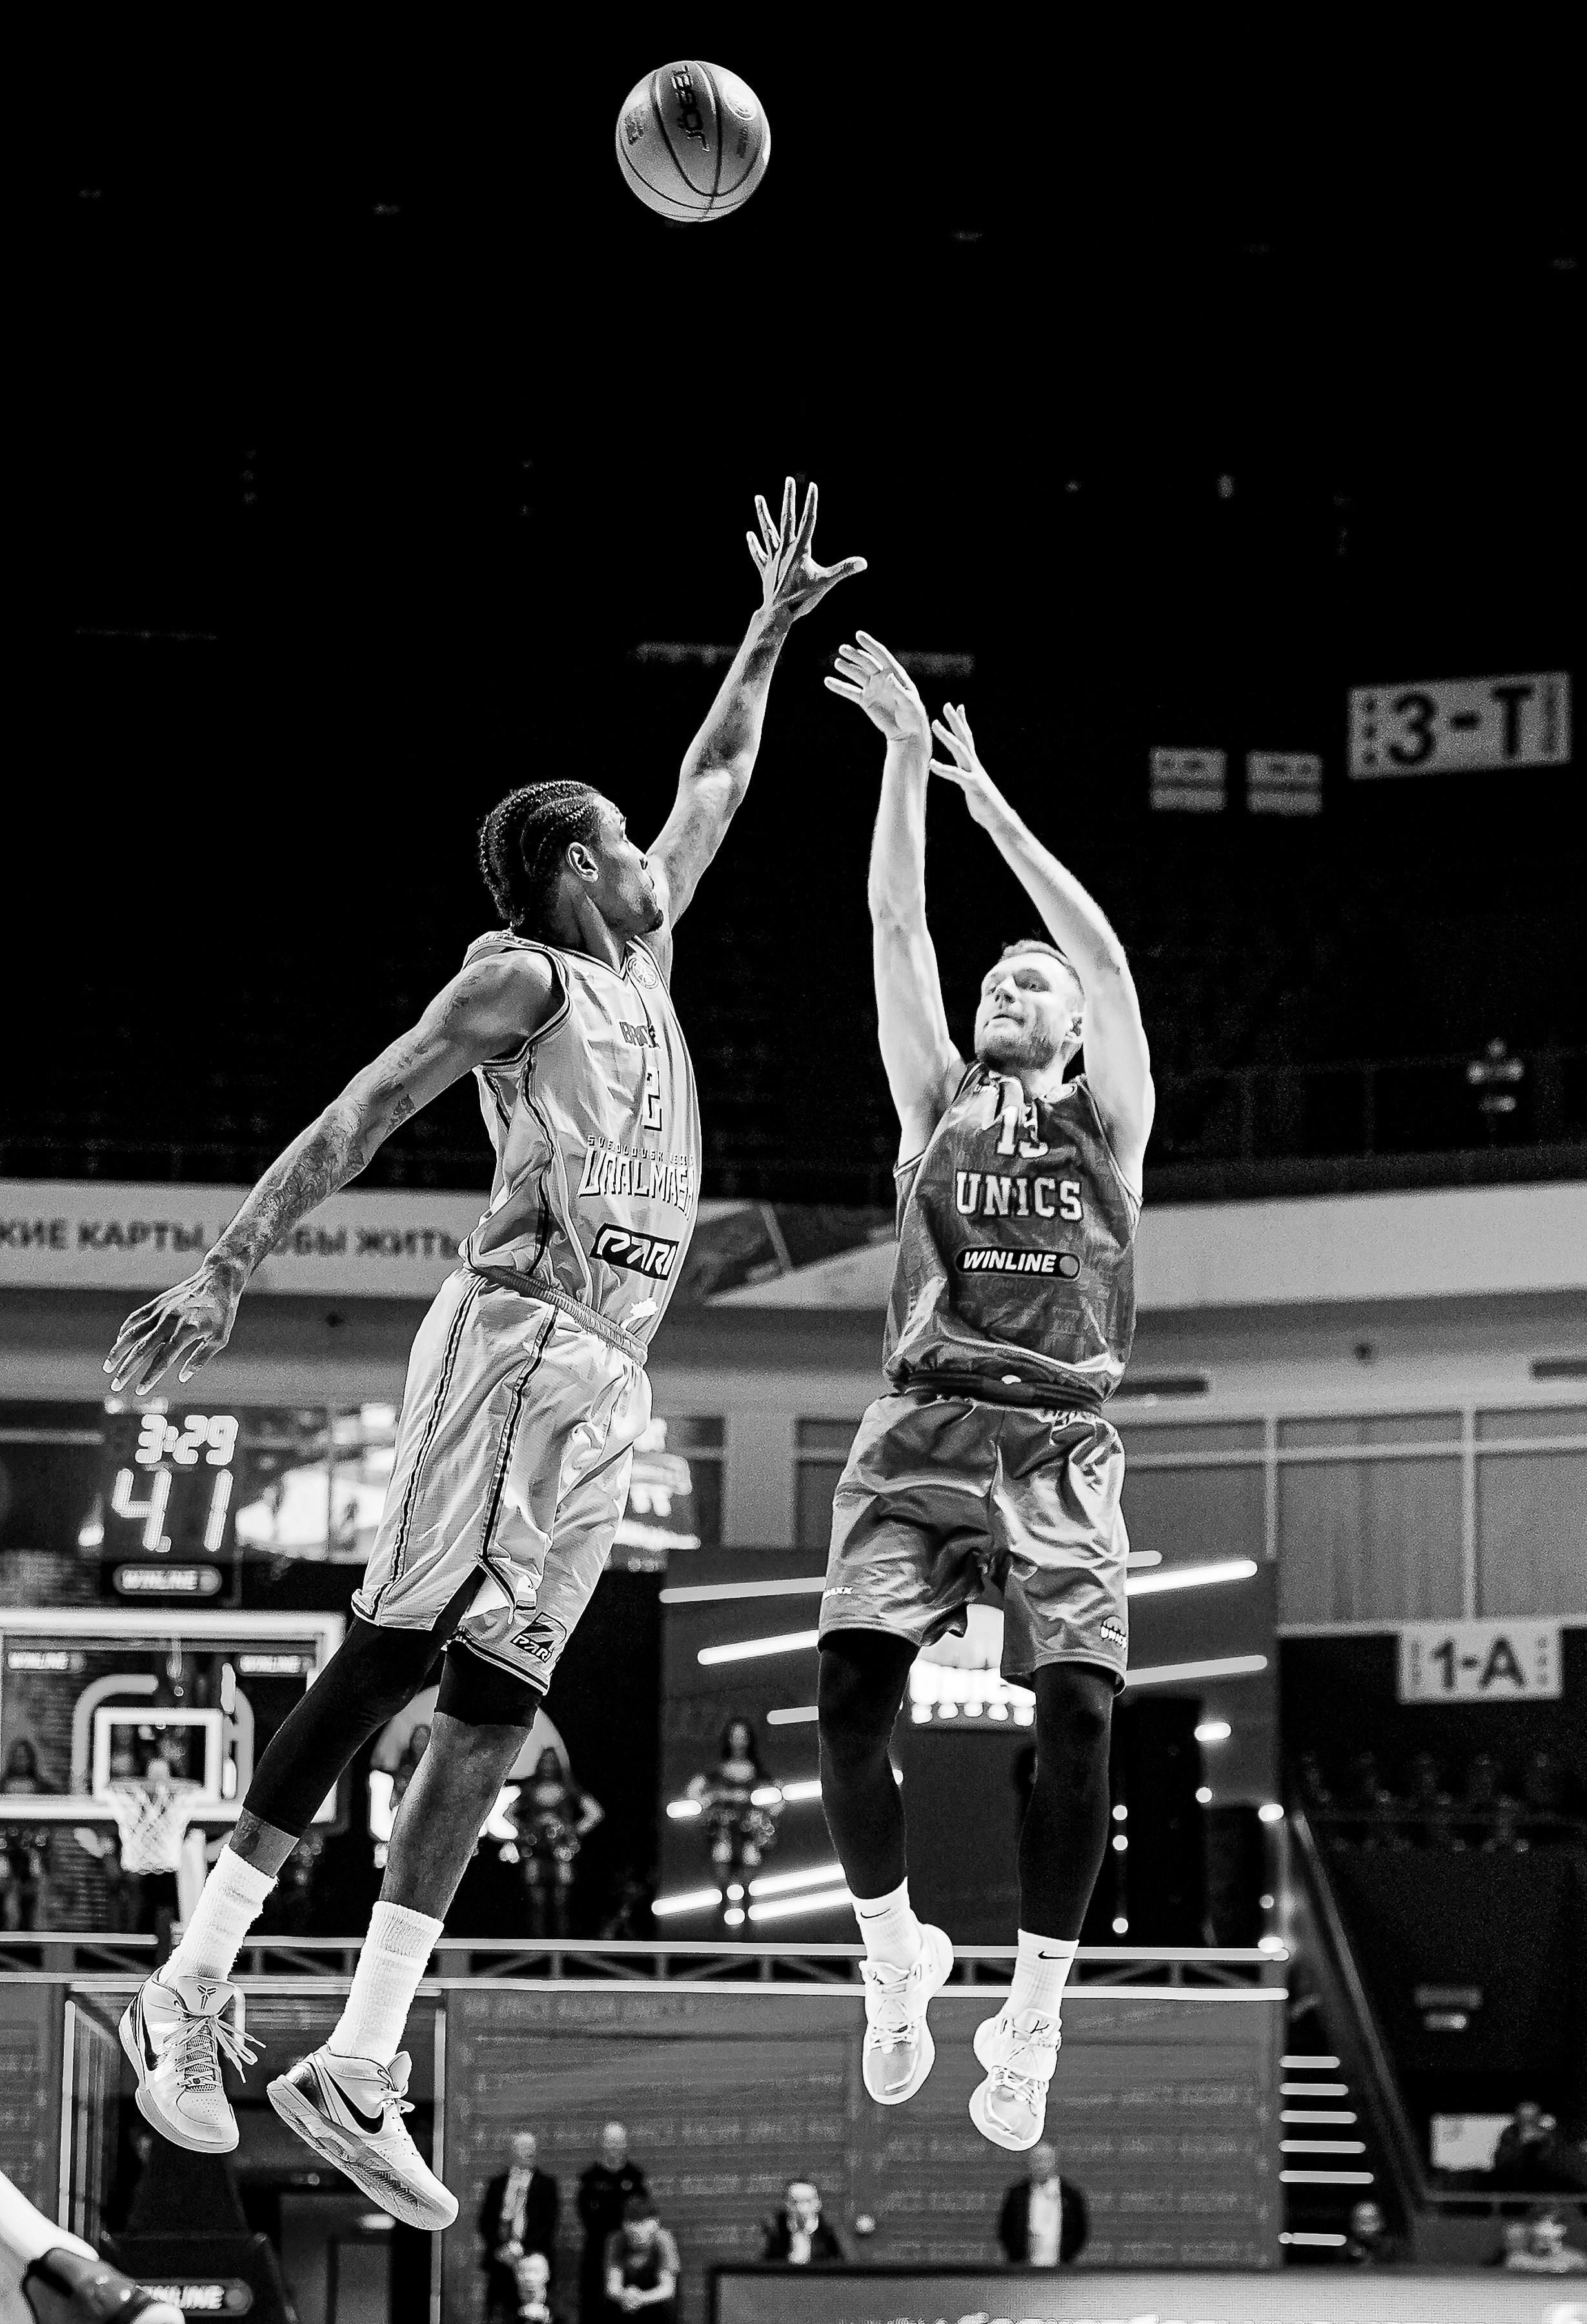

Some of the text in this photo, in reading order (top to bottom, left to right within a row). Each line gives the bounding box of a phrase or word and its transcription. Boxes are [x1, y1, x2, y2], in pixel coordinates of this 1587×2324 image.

[642, 1070, 663, 1132] 2
[955, 1170, 1084, 1222] UNICS
[596, 1228, 677, 1276] PARI
[962, 1250, 1056, 1274] WINLINE
[135, 1414, 239, 1465] 3:29
[512, 1634, 552, 1662] PARI
